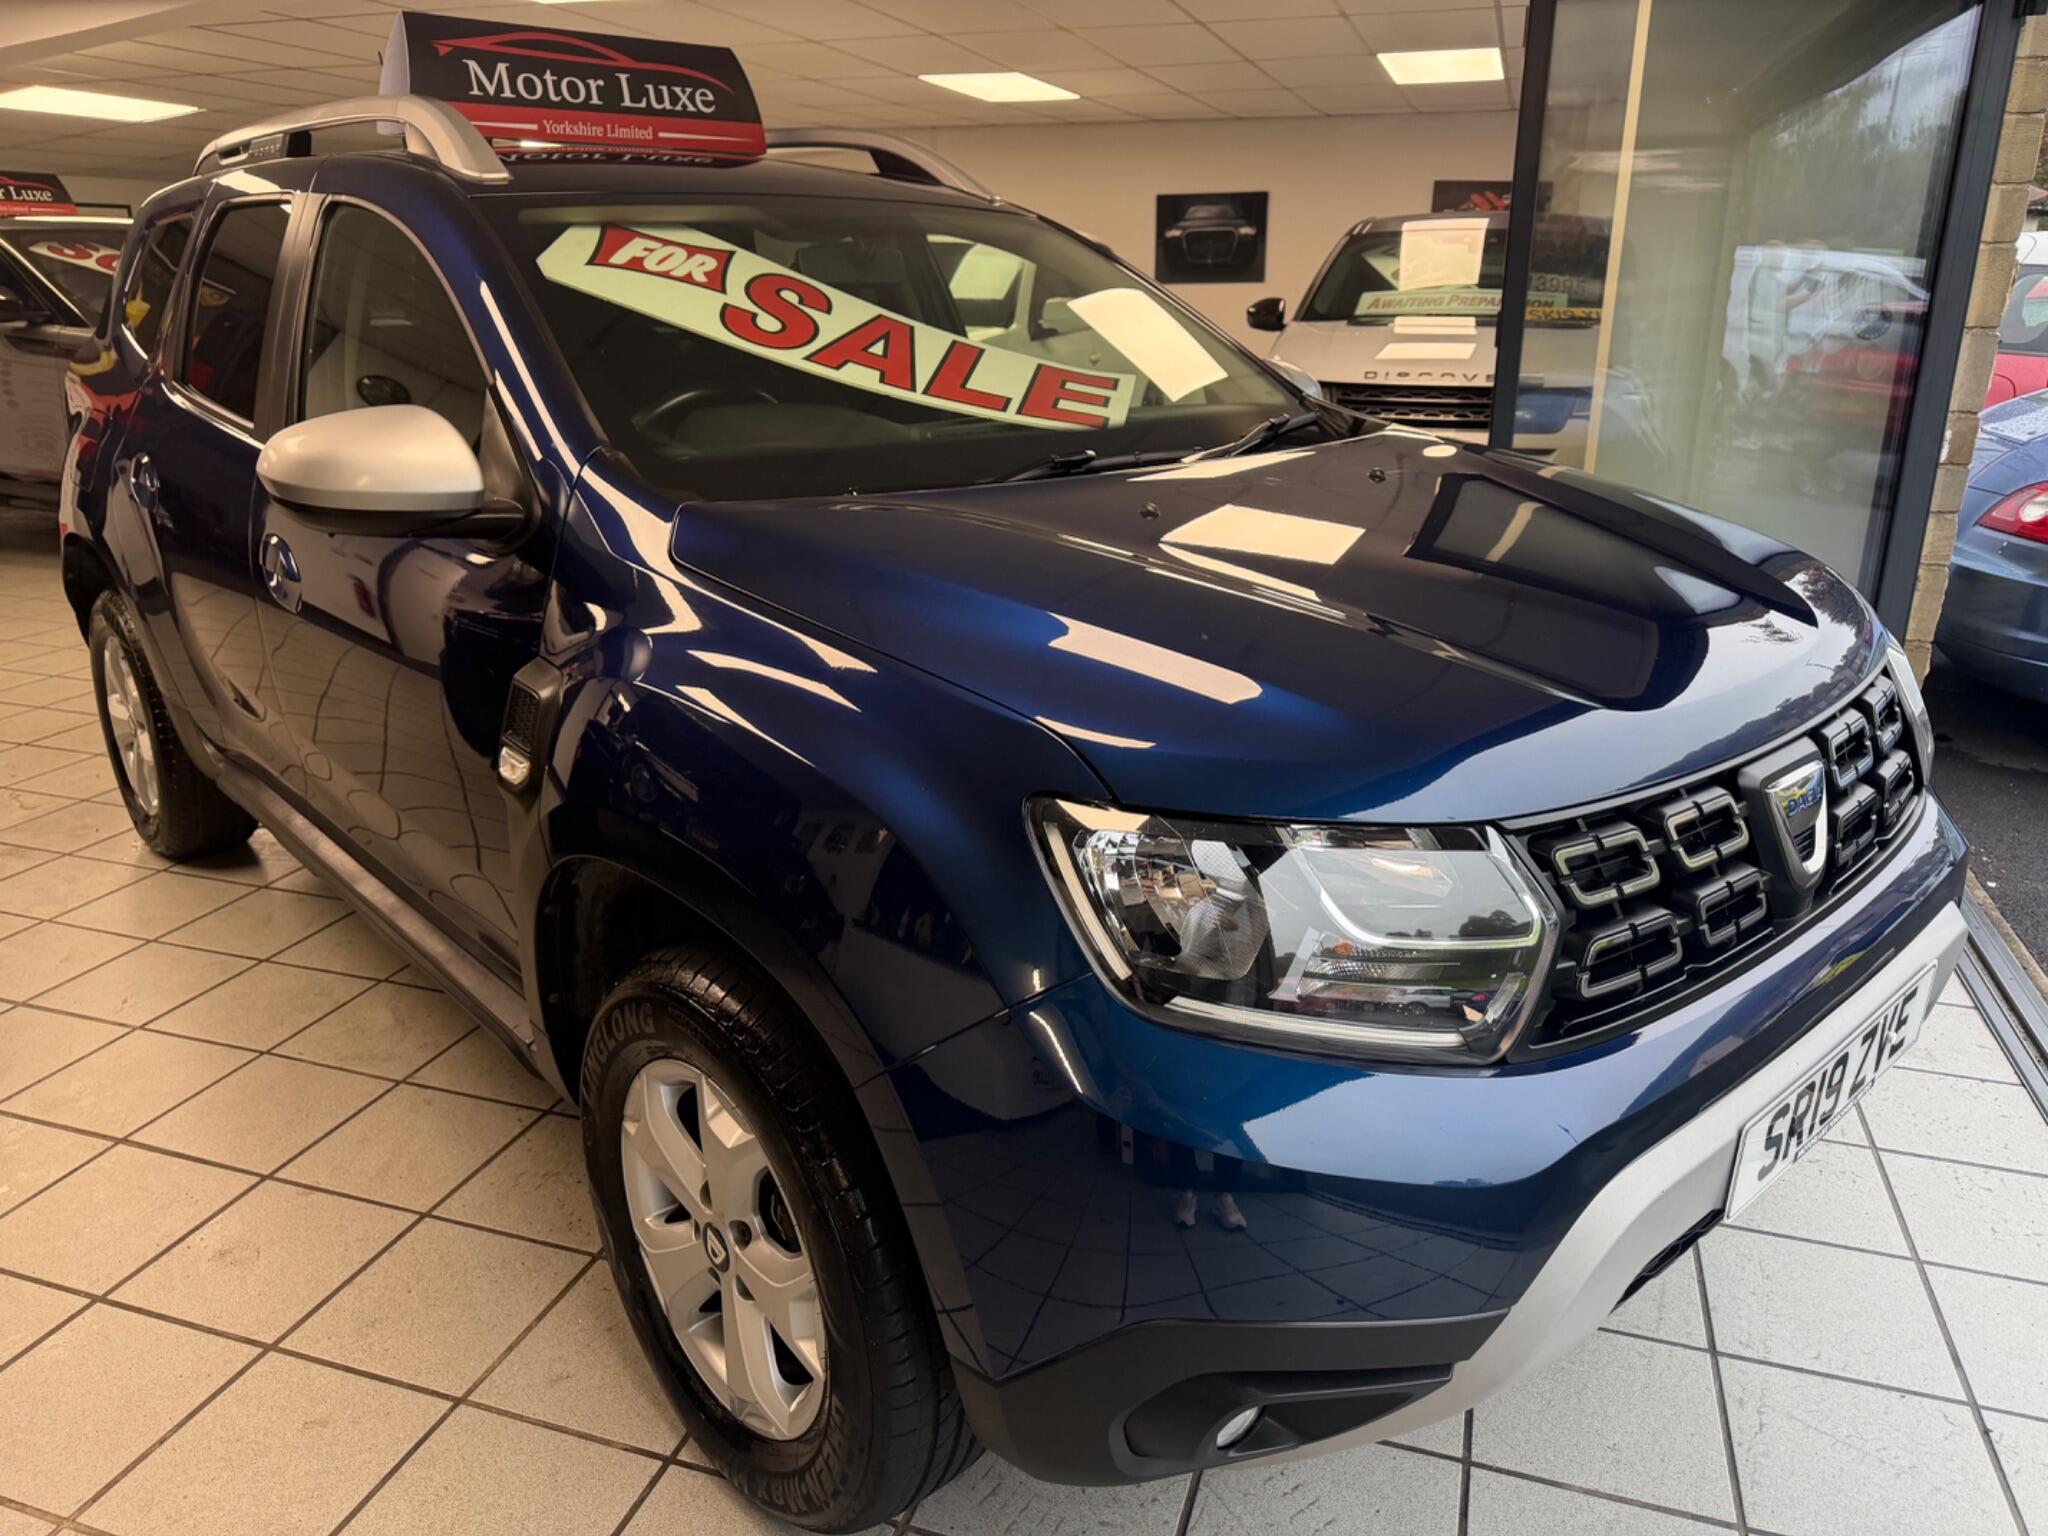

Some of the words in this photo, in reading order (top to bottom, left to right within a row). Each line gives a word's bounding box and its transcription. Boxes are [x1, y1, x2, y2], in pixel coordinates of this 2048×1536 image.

[462, 59, 604, 106] Motor
[615, 73, 717, 113] Luxe
[543, 119, 604, 138] Yorkshire
[607, 123, 653, 140] Limited
[9, 186, 53, 201] Luxe
[607, 234, 716, 285] FOR
[720, 272, 1119, 428] SALE
[1757, 1051, 1850, 1182] SR19
[1848, 986, 1918, 1099] ZVE
